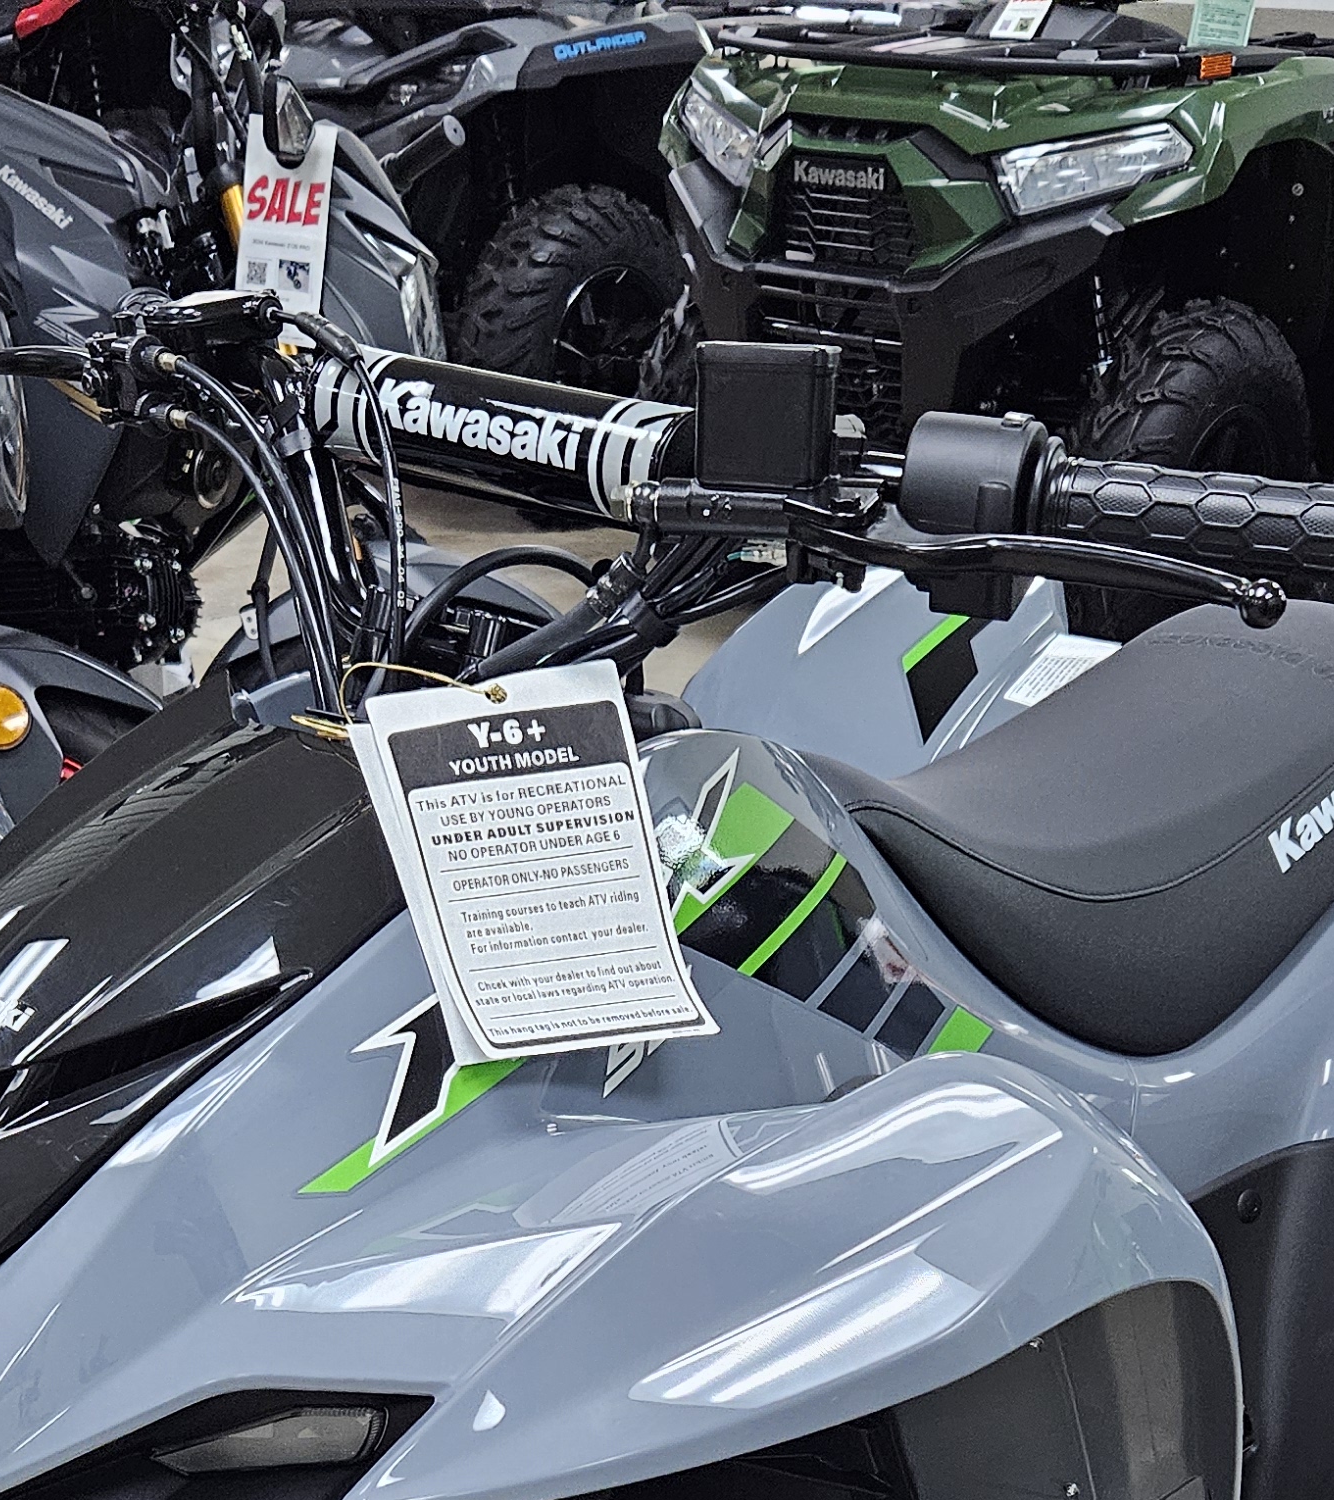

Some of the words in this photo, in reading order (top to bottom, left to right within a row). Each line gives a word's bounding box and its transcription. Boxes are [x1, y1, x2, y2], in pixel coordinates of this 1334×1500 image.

[553, 31, 647, 61] OUTLANDER
[794, 161, 884, 190] Kawasaki
[247, 175, 325, 226] SALE
[378, 377, 582, 471] Kawasaki
[449, 754, 512, 776] YOUTH
[516, 746, 580, 769] MODEL
[415, 796, 447, 813] This
[450, 792, 478, 808] ATV
[481, 790, 494, 803] is
[496, 789, 515, 802] for
[517, 774, 627, 800] RECREATIONAL
[431, 827, 483, 846] UNDER
[487, 822, 532, 840] ADULT
[536, 809, 635, 833] SUPERVISION
[440, 811, 467, 827] USE
[470, 809, 485, 823] BY
[488, 803, 535, 821] YOUNG
[537, 795, 611, 816] OPERATORS
[447, 849, 467, 862] NO
[470, 840, 536, 859] OPERATOR
[539, 835, 582, 851] UNDER
[585, 831, 610, 845] AGE
[613, 829, 620, 840] 6
[453, 873, 509, 892] OPERATOR
[511, 867, 559, 885] ONLY-NO
[560, 858, 629, 877] PASSENGERS
[460, 908, 504, 924] Training
[505, 903, 544, 917] courses
[545, 901, 556, 912] to
[558, 897, 586, 911] teach
[588, 893, 607, 907] ATV
[610, 890, 640, 904] riding
[466, 928, 483, 939] are
[485, 921, 534, 936] available.
[470, 942, 487, 955] For
[489, 934, 549, 952] information
[550, 930, 587, 945] contact
[591, 927, 613, 941] your
[615, 921, 649, 935] dealer.
[474, 994, 500, 1007] state
[501, 993, 511, 1003] or
[513, 988, 537, 1002] local
[538, 986, 560, 999] laws
[561, 981, 607, 999] regarding
[608, 979, 626, 991] ATV
[628, 974, 676, 990] operation.
[509, 974, 531, 987] with
[532, 974, 554, 988] your
[555, 969, 584, 982] dealer
[586, 968, 596, 979] to
[597, 964, 616, 978] find
[617, 964, 634, 975] out
[635, 960, 662, 973] about
[488, 1025, 510, 1038] This
[510, 1023, 534, 1036] hang
[535, 1021, 551, 1034] tag
[551, 1019, 560, 1029] is
[561, 1017, 576, 1029] not
[577, 1016, 588, 1026] to
[588, 1015, 601, 1026] be
[602, 1010, 640, 1024] removed
[641, 1006, 670, 1018] before
[671, 1003, 693, 1015] sale.
